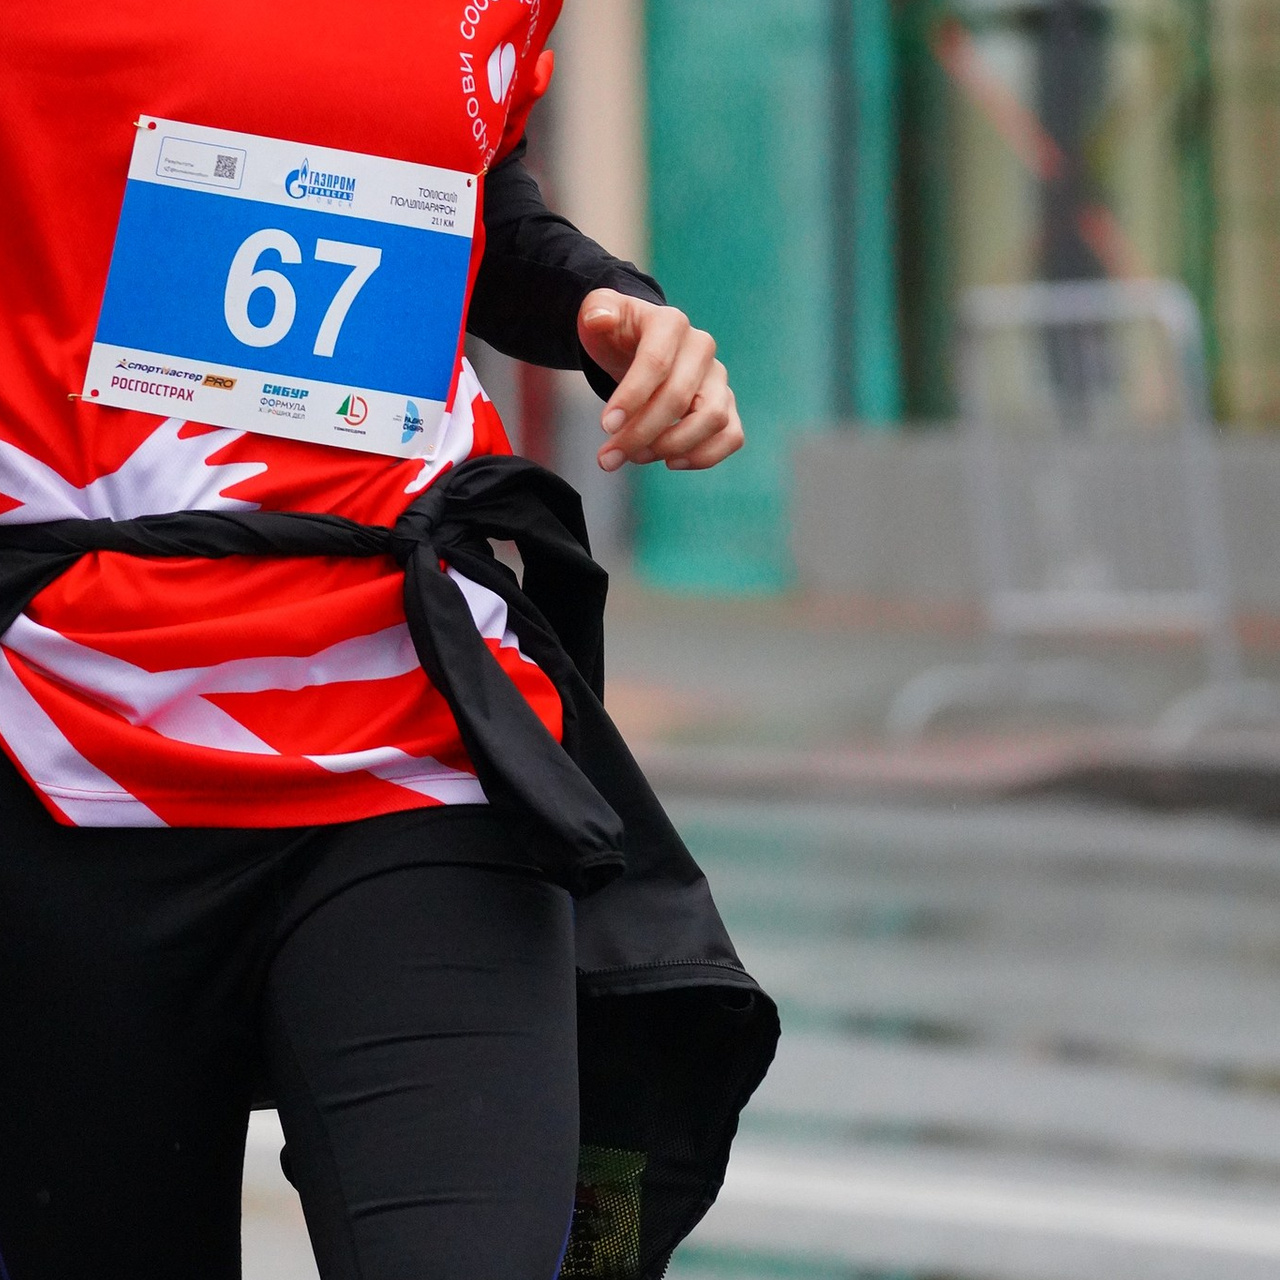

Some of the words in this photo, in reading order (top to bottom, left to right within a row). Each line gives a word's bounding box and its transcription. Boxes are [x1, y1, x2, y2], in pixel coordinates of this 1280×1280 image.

[309, 171, 356, 192] ГАЗПРОМ
[418, 187, 458, 204] ТОМСКИЙ
[390, 195, 456, 216] ПОЛУМАРАФОН
[223, 227, 382, 358] 67
[111, 375, 195, 402] РОСГОССТРАХ
[204, 375, 234, 389] PRO
[262, 383, 309, 400] СИБУР
[260, 397, 306, 412] ФОРМУЛА
